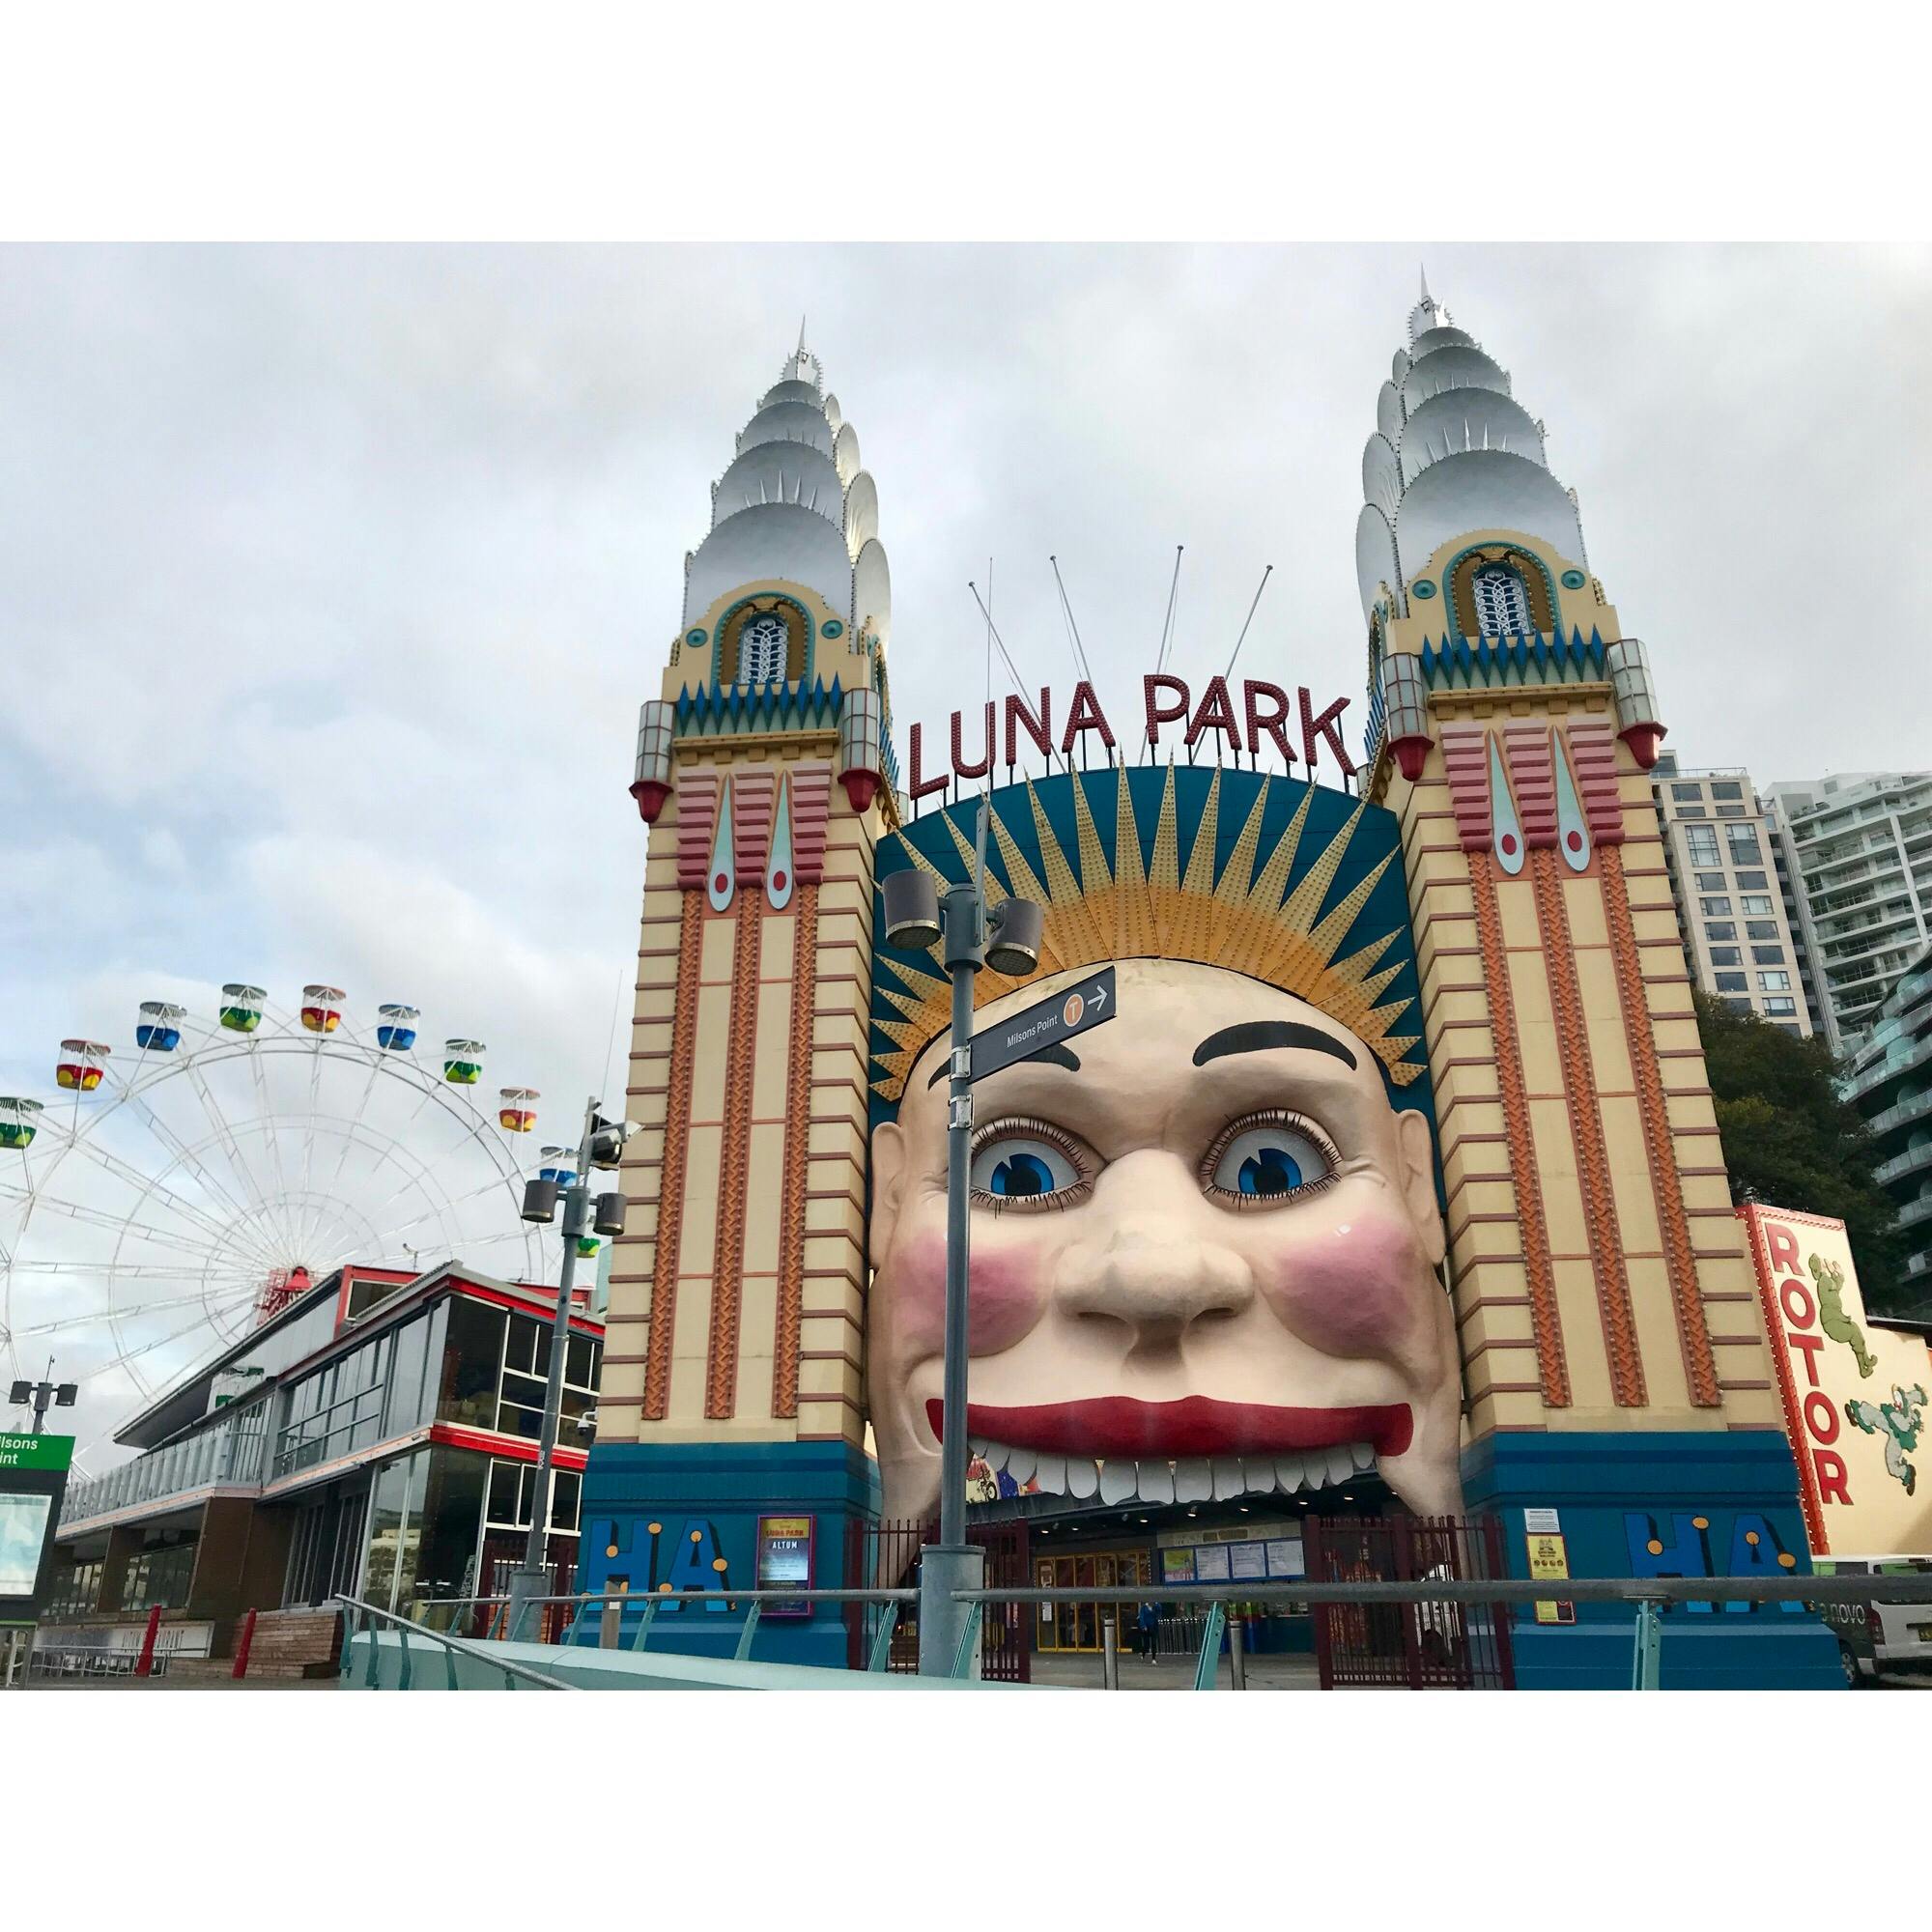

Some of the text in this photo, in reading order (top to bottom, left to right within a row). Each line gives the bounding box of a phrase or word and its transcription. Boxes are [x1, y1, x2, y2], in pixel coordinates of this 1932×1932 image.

[910, 674, 1357, 801] LUNA PARK
[1007, 1026, 1037, 1048] Milsons
[1037, 1014, 1059, 1034] Point
[1765, 1221, 1854, 1506] ROTOR
[585, 1520, 730, 1612] HA
[772, 1541, 798, 1549] ALTUM
